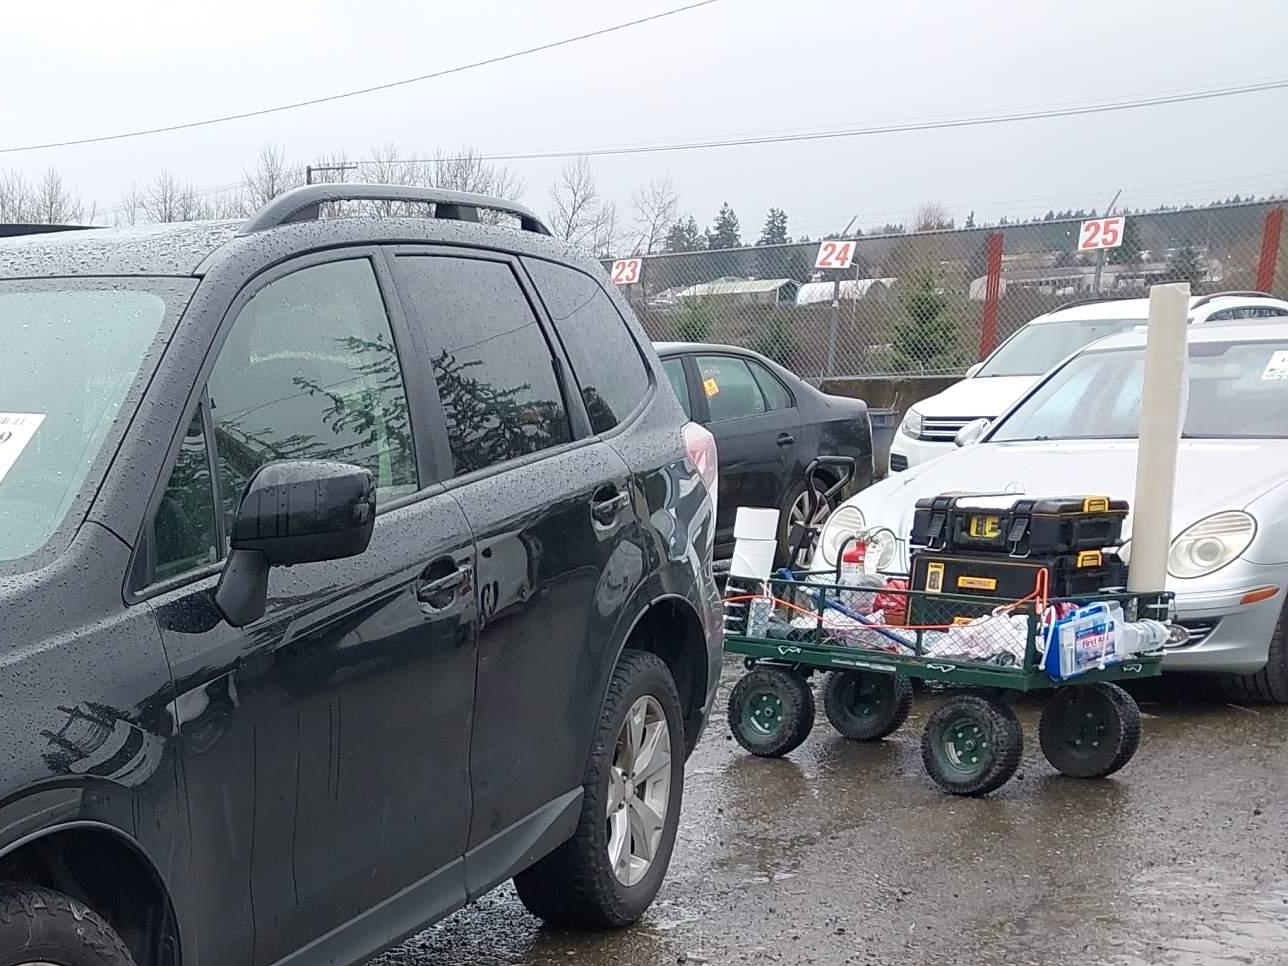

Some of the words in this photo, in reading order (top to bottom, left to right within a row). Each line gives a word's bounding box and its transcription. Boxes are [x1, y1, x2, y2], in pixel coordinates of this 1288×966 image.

[1082, 218, 1120, 248] 25
[819, 242, 851, 266] 24
[614, 260, 639, 282] 23
